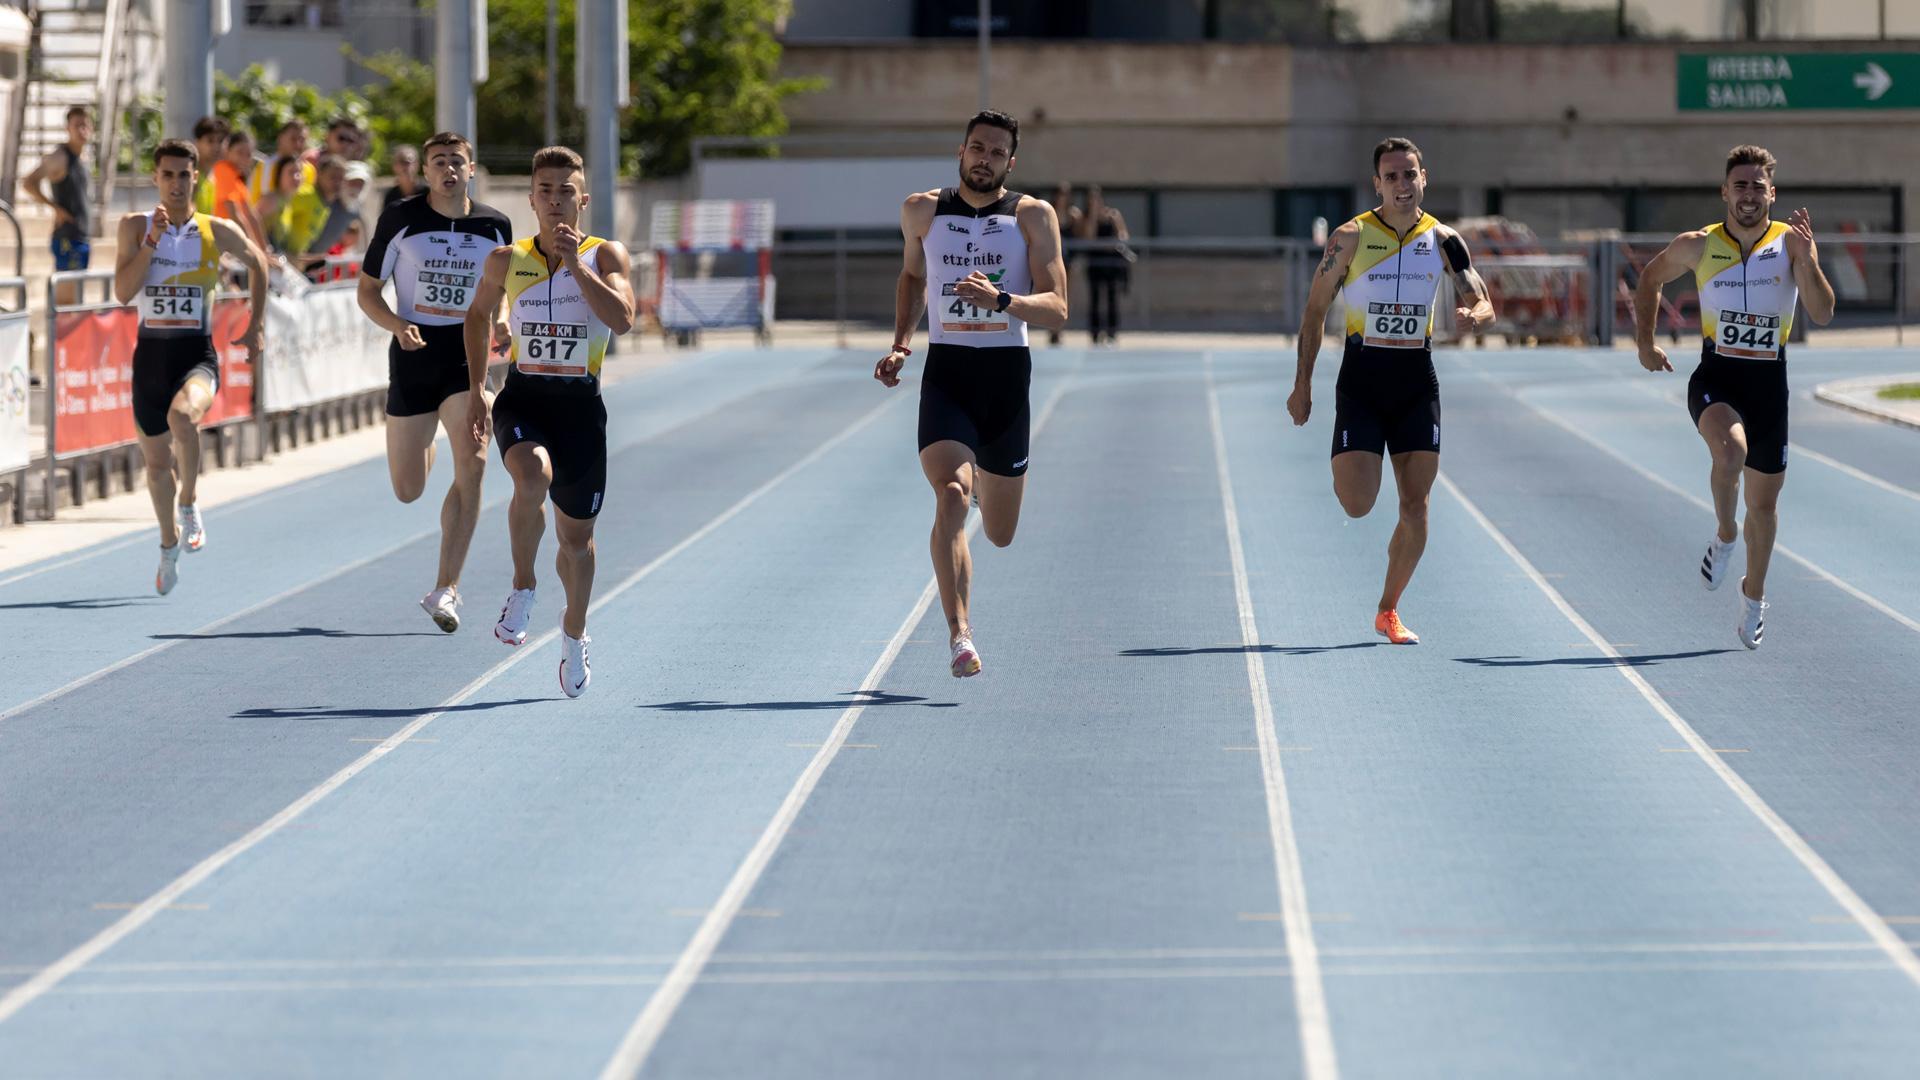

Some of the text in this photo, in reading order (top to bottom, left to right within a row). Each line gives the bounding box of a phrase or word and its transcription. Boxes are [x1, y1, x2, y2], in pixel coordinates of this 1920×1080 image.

[1707, 56, 1793, 80] IRTEERA
[1706, 83, 1788, 107] SALIDA
[425, 285, 466, 306] 398
[153, 298, 194, 315] 514
[534, 324, 573, 337] A4XKM
[1375, 316, 1418, 335] 620
[1723, 325, 1774, 349] 944
[527, 338, 578, 360] 617
